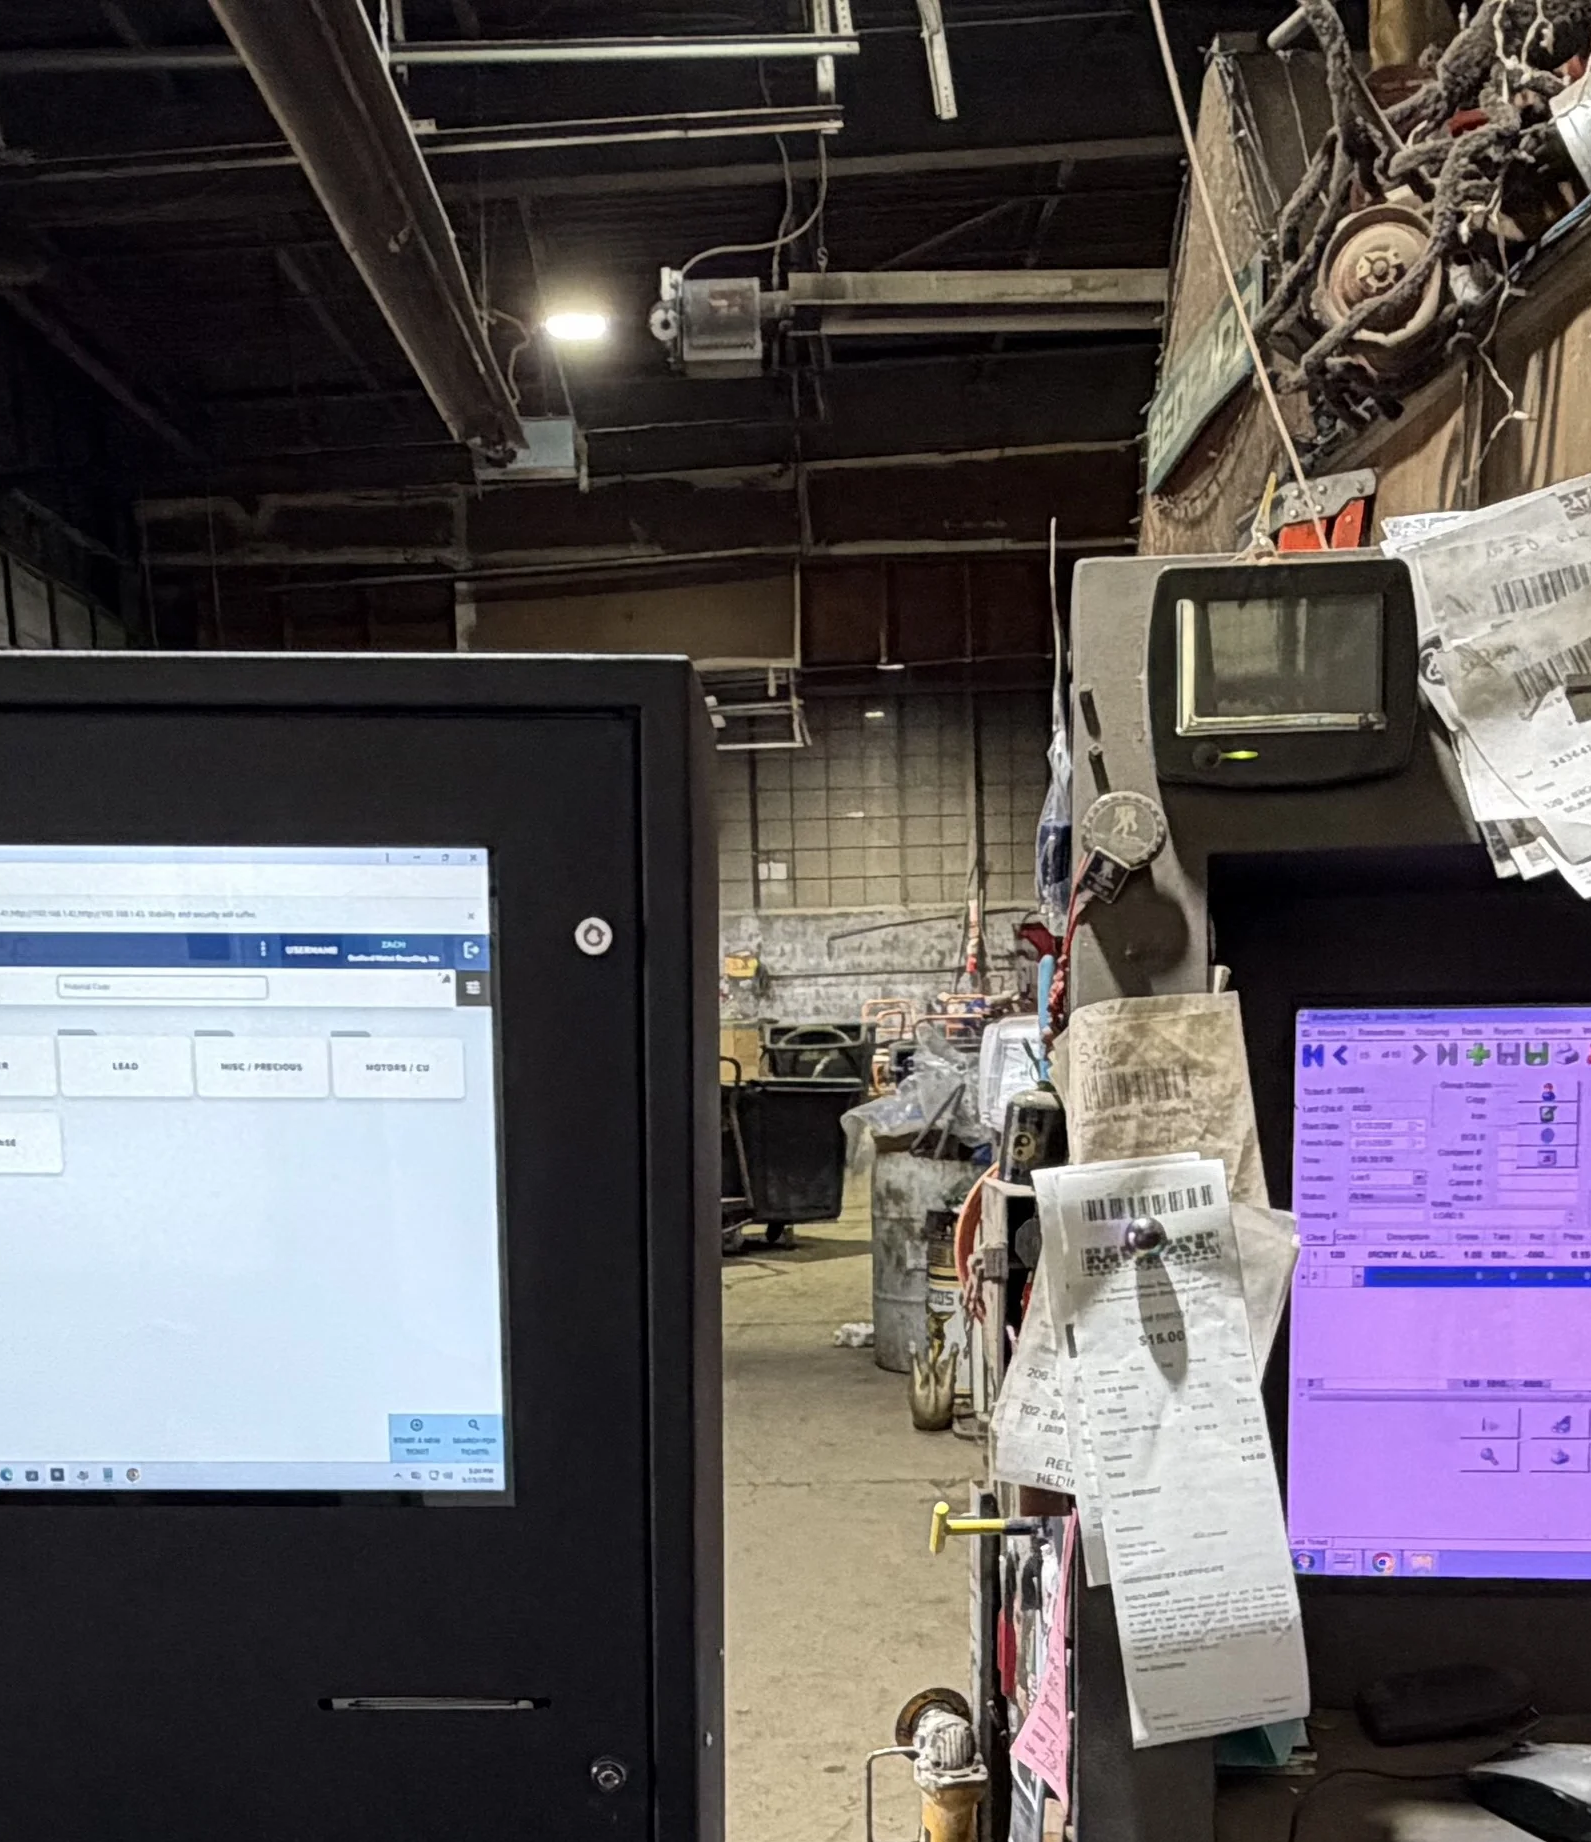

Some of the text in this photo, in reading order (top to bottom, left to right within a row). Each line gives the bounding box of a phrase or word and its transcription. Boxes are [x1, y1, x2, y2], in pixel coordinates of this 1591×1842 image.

[285, 941, 407, 955] USERNAME ZACH
[112, 1062, 139, 1071] LEAD
[220, 1062, 246, 1072] MISC
[254, 1062, 303, 1072] PRECIOUS
[365, 1064, 407, 1073] MOTORS
[1139, 1330, 1186, 1346] $15.00
